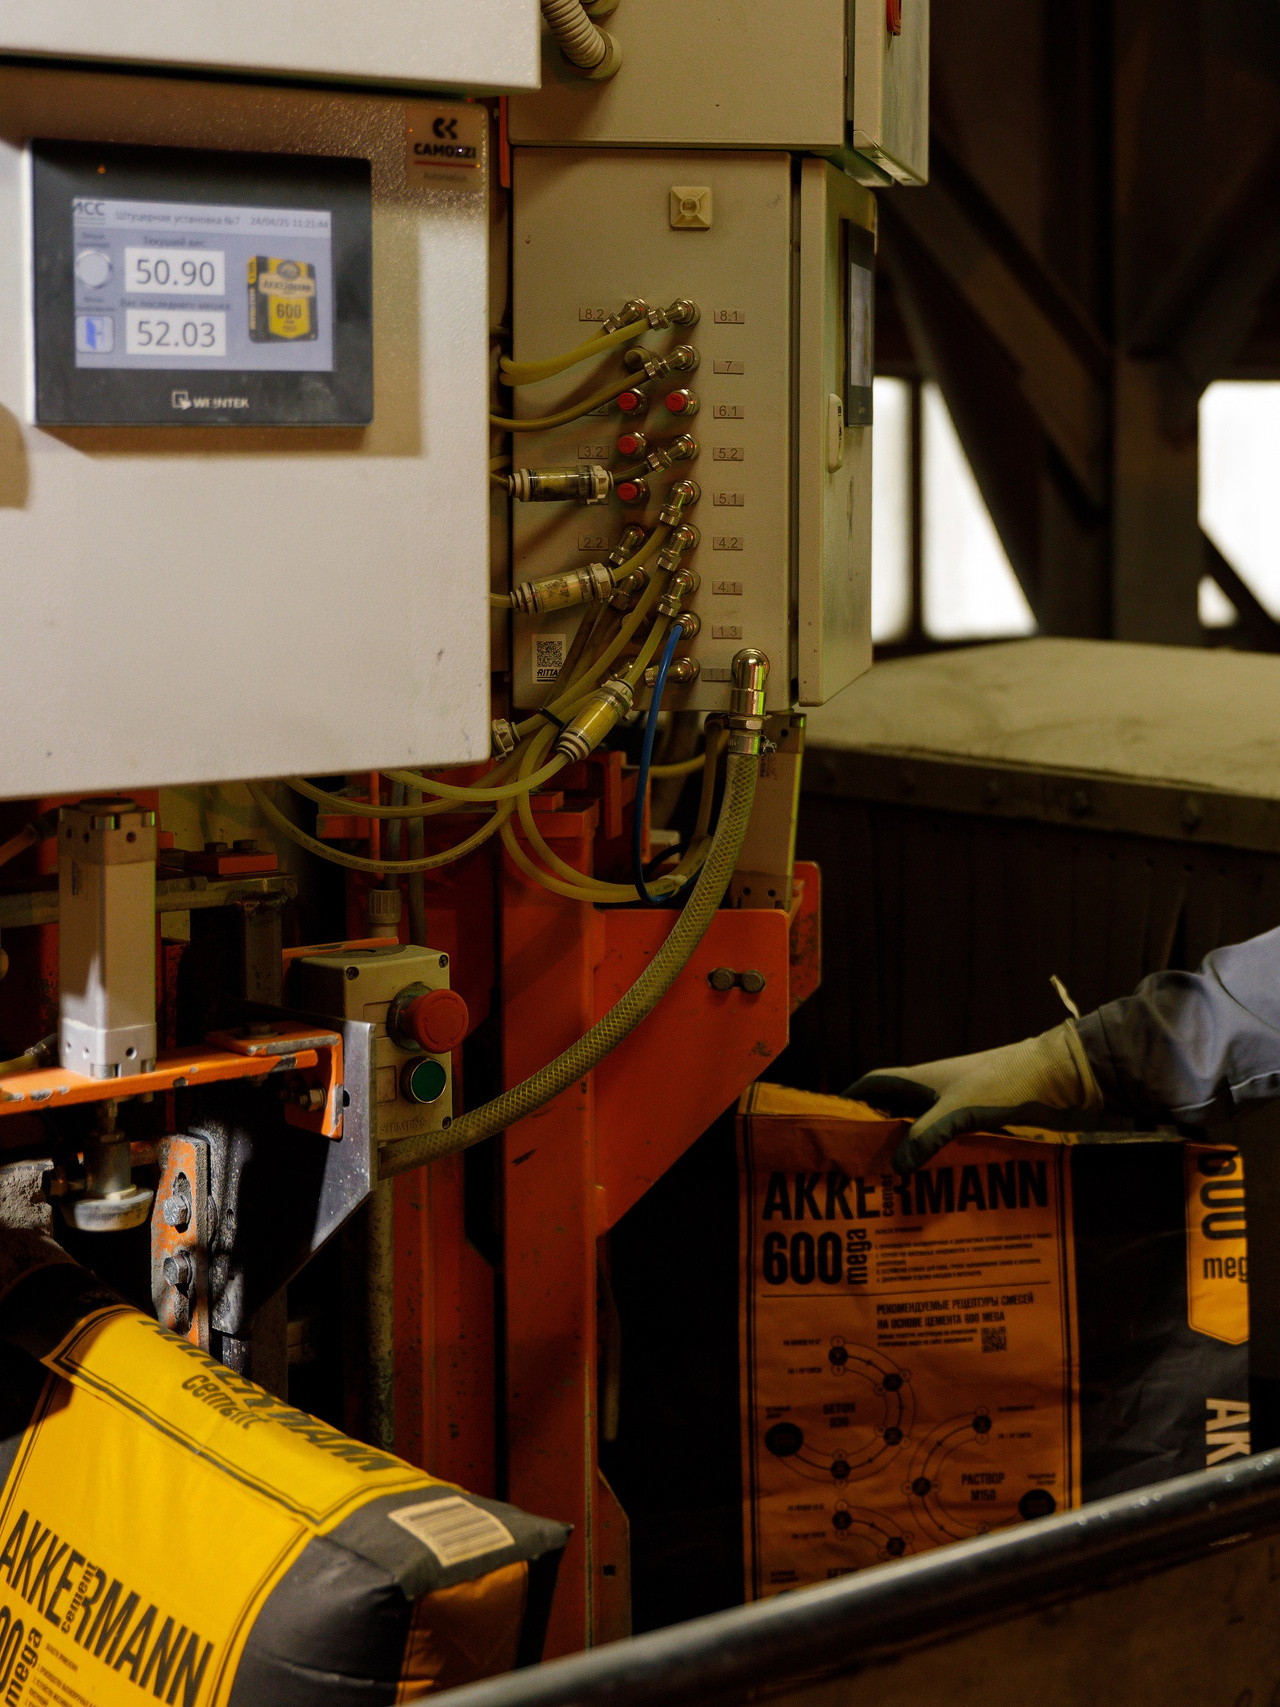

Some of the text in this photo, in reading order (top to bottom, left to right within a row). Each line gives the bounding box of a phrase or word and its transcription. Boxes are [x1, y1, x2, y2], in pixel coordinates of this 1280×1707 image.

[413, 142, 477, 159] CAMOZZI
[136, 258, 215, 286] 50.90
[276, 303, 302, 319] 600
[585, 308, 605, 319] 8.2
[719, 310, 739, 321] 8.1
[137, 320, 216, 347] 52.03
[724, 361, 733, 371] 7
[719, 406, 738, 416] 6.1
[584, 446, 603, 457] 3.2
[718, 448, 738, 459] 5.2
[718, 493, 737, 504] 5.1
[583, 537, 603, 548] 2.2
[718, 538, 738, 549] 4.2
[718, 582, 737, 593] 4.1
[719, 626, 738, 636] 1.3
[537, 668, 559, 677] RITTA
[379, 1115, 430, 1134] SIEMENS
[763, 1159, 1048, 1221] AKKERMANN
[762, 1227, 872, 1286] 600 mega
[1202, 1255, 1250, 1284] meg
[876, 1291, 1034, 1315] РЕКОМЕНДУЕМЫЕ РЕЦЕПТУРЫ СМЕСЕЙ
[876, 1318, 889, 1330] НА
[890, 1317, 922, 1329] ОСНОВЕ
[924, 1314, 962, 1327] ЦЕМЕНТА
[964, 1313, 980, 1324] 600
[181, 1374, 268, 1430] cement
[961, 1472, 1005, 1487] РАСТВОР
[60, 1560, 99, 1634] cement
[0, 1509, 215, 1707] AKKERMANN
[5, 1627, 43, 1707] mega
